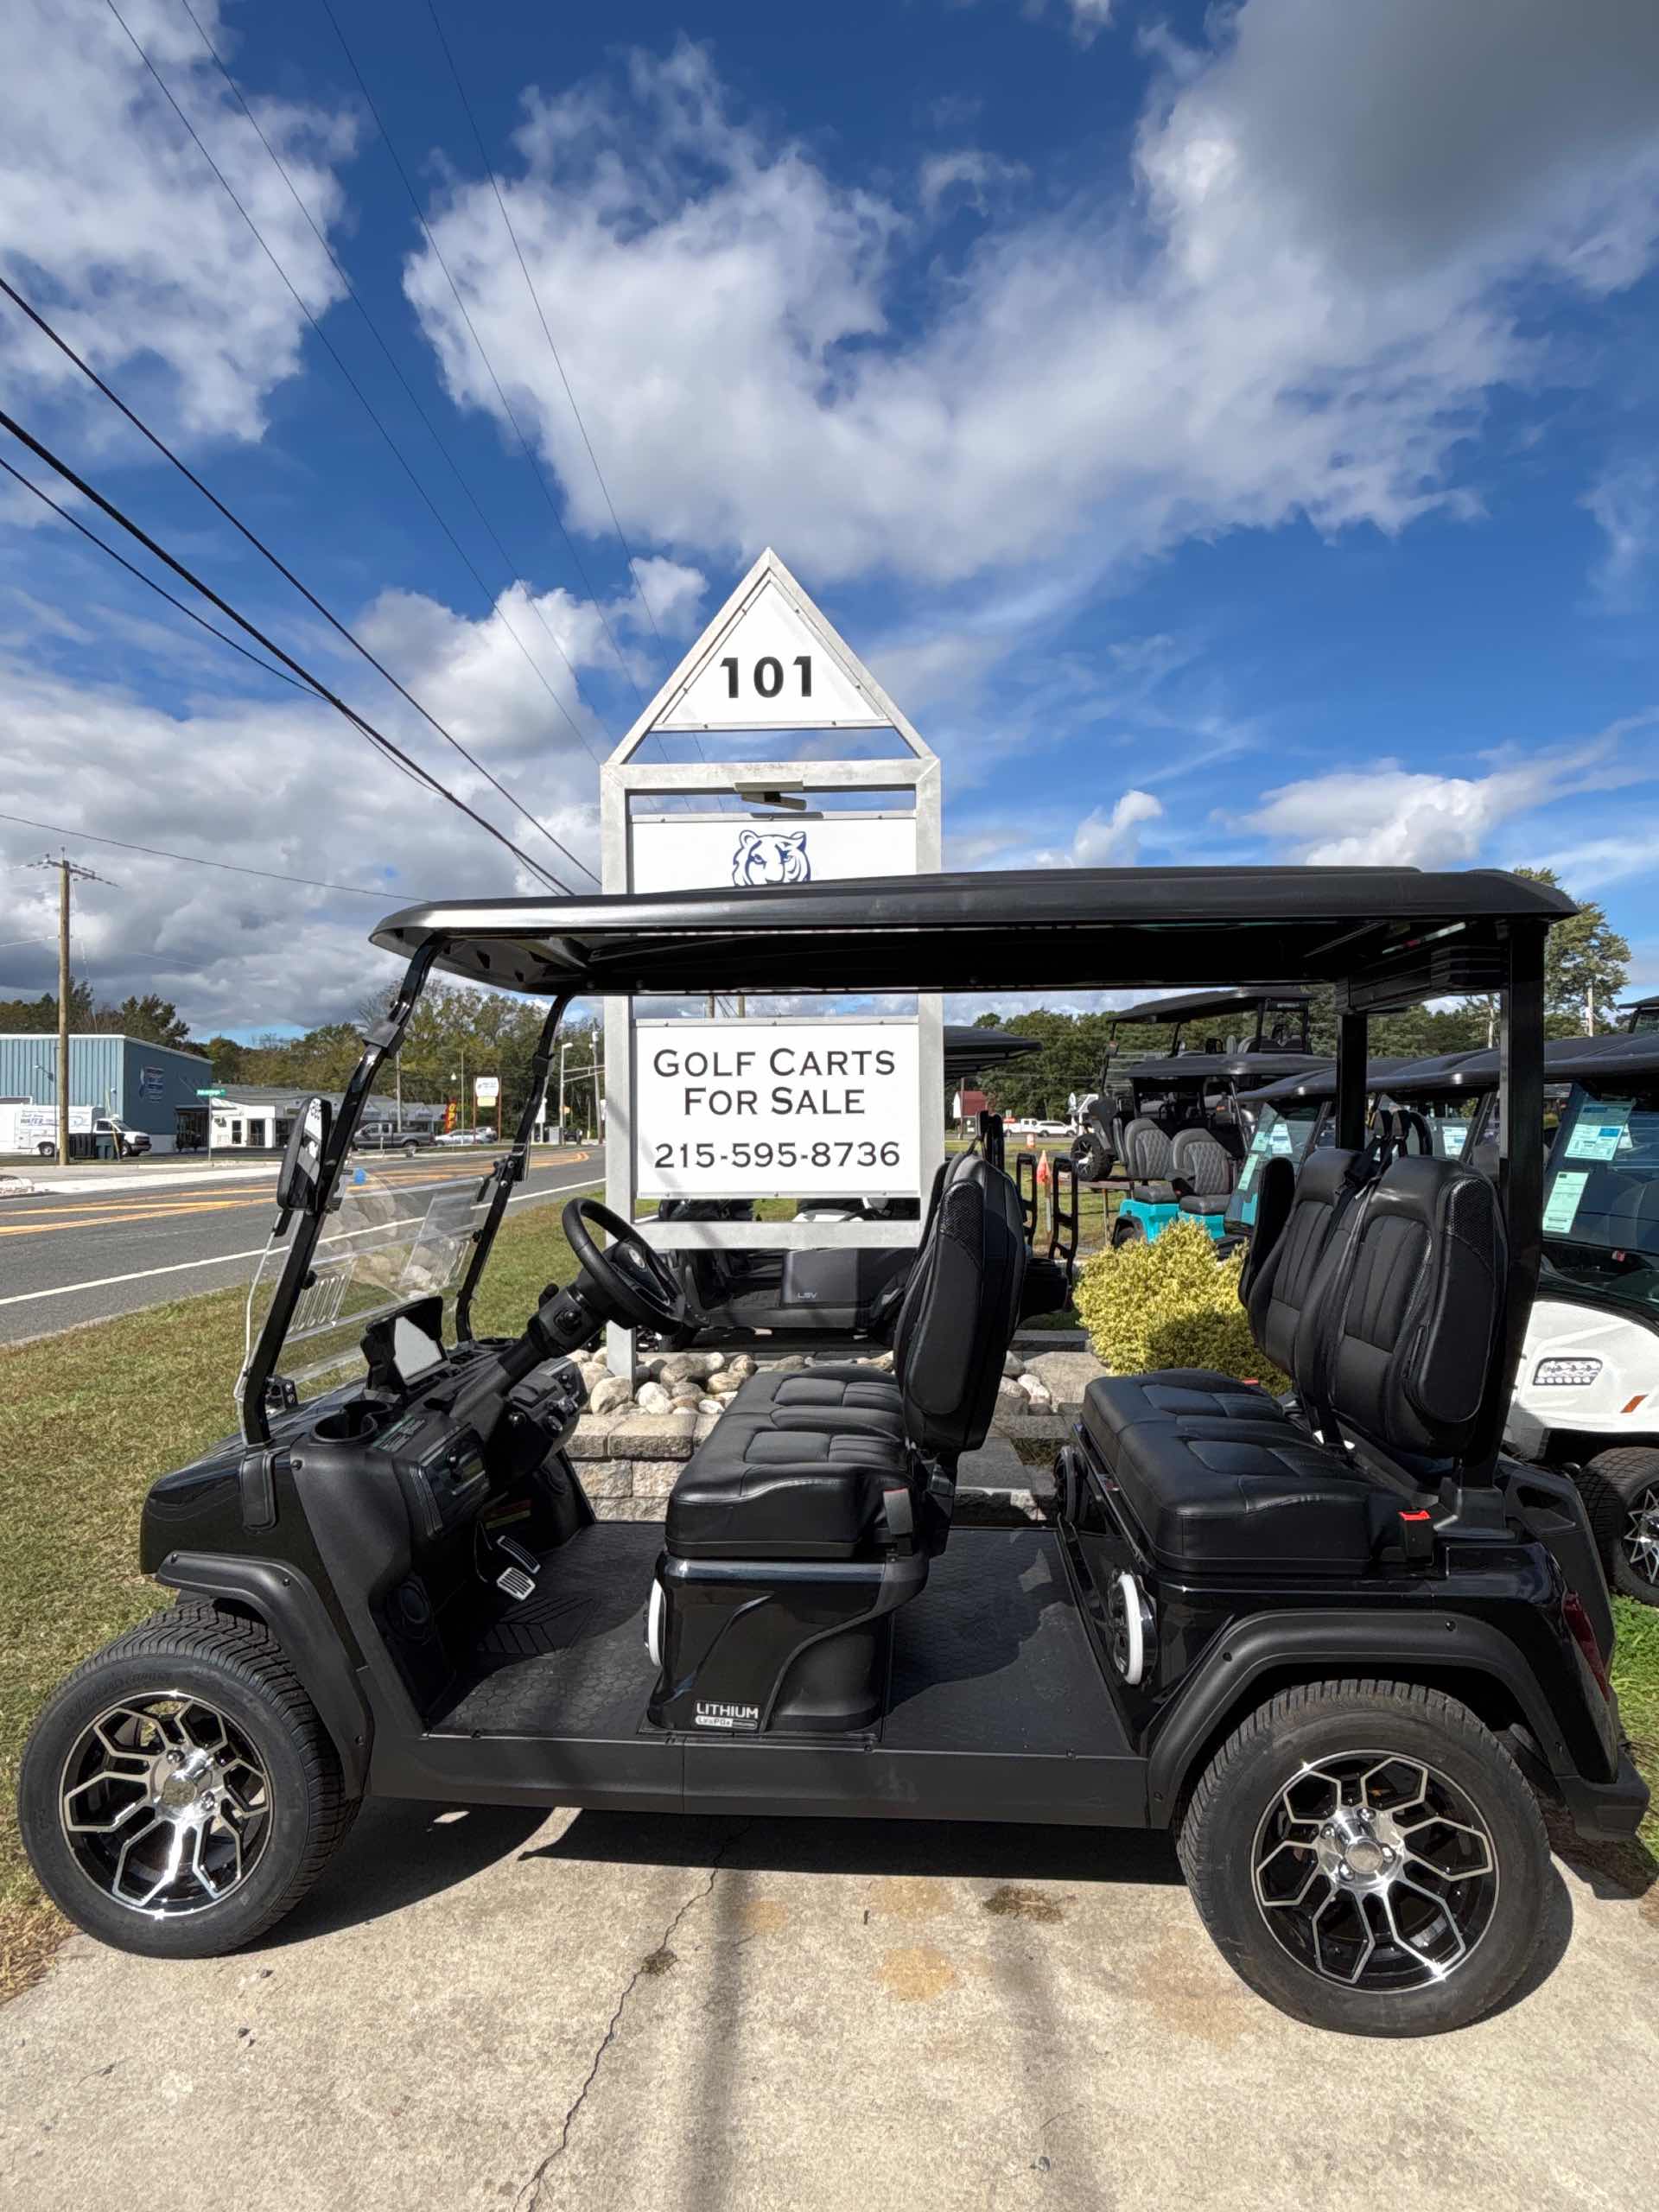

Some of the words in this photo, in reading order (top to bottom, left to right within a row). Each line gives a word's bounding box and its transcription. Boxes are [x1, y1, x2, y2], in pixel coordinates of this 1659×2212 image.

[720, 656, 811, 698] 101
[653, 1048, 756, 1077] GOLF
[769, 1047, 895, 1077] CARTS
[684, 1086, 758, 1116] FOR
[771, 1085, 865, 1116] SALE
[654, 1141, 900, 1168] 215-595-8736
[696, 1702, 759, 1719] LITHIUM
